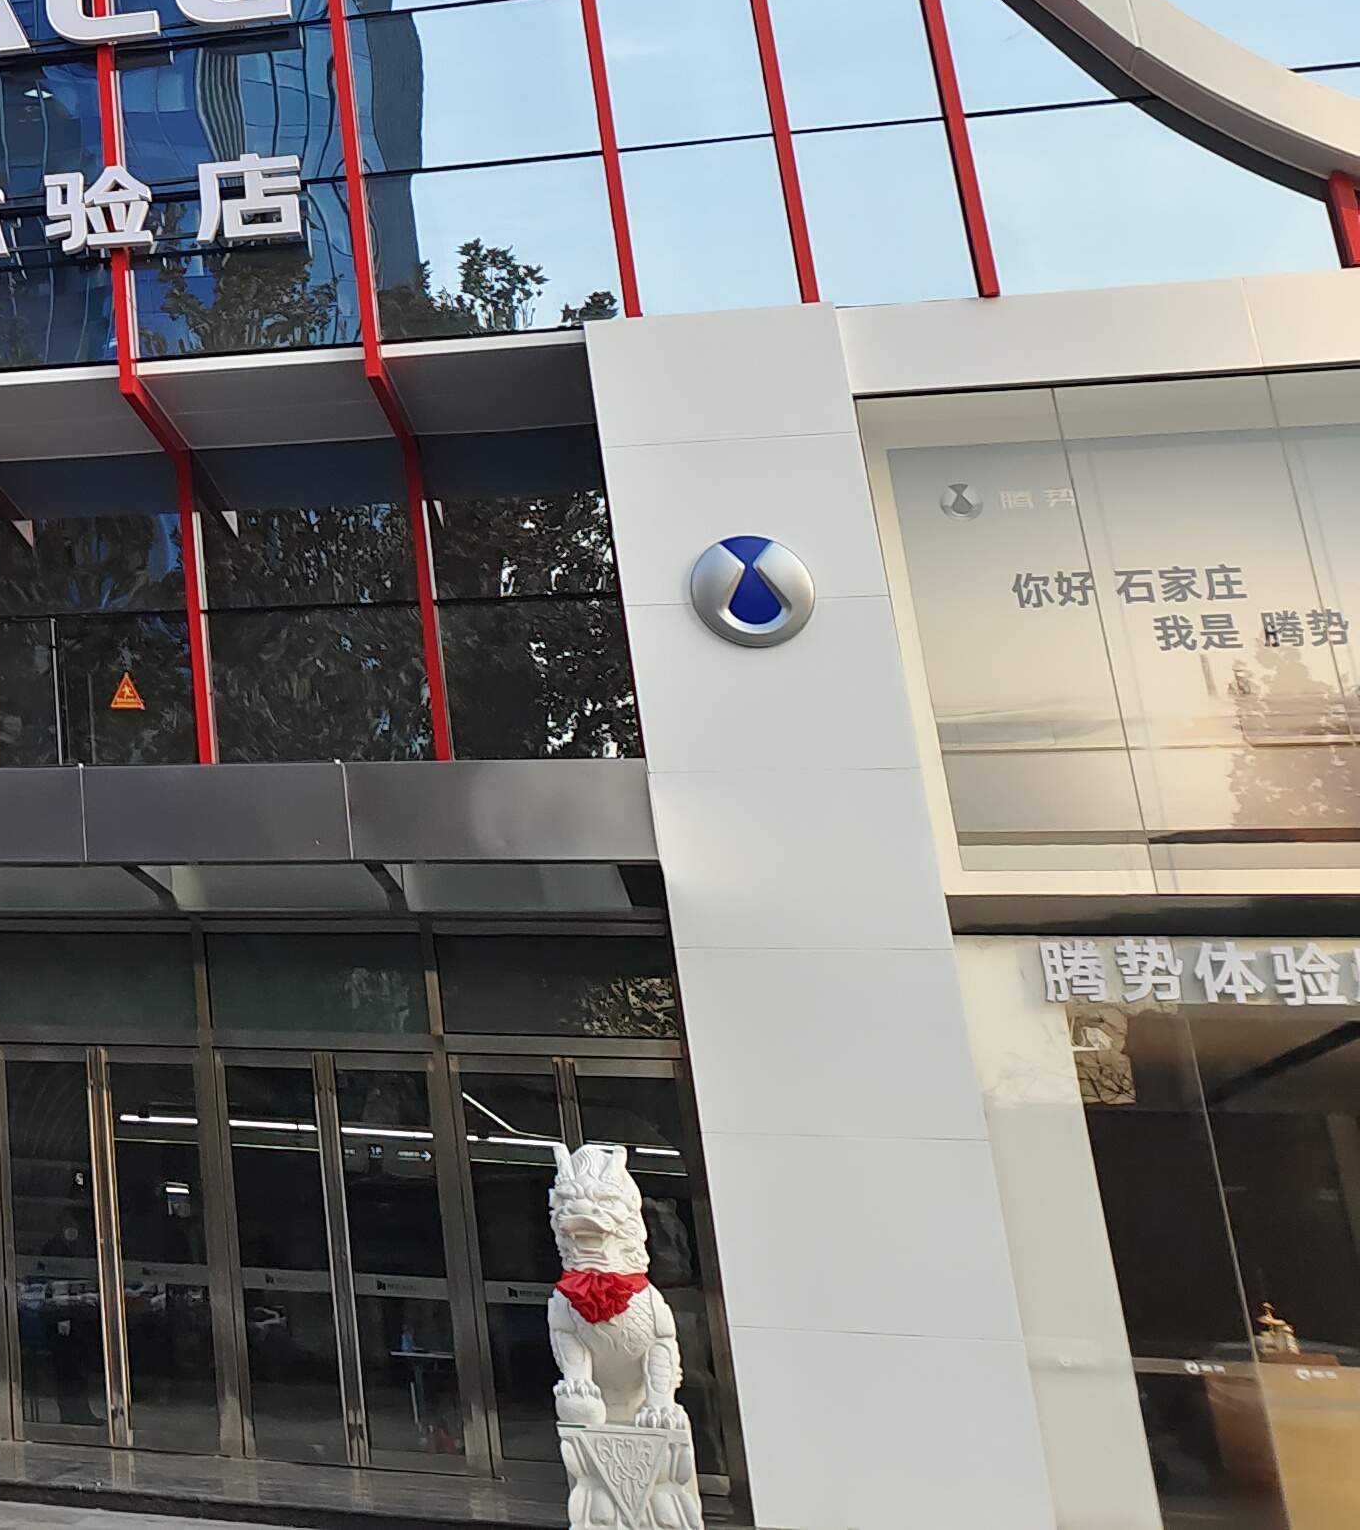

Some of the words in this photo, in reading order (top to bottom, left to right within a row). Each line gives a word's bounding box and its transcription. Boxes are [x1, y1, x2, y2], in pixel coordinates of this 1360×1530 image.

[1012, 571, 1096, 609] 你好
[1114, 564, 1248, 605] 石家庄
[1153, 614, 1244, 652] 我是
[1260, 608, 1350, 648] 腾势
[1039, 938, 1360, 1007] 腾势体验
